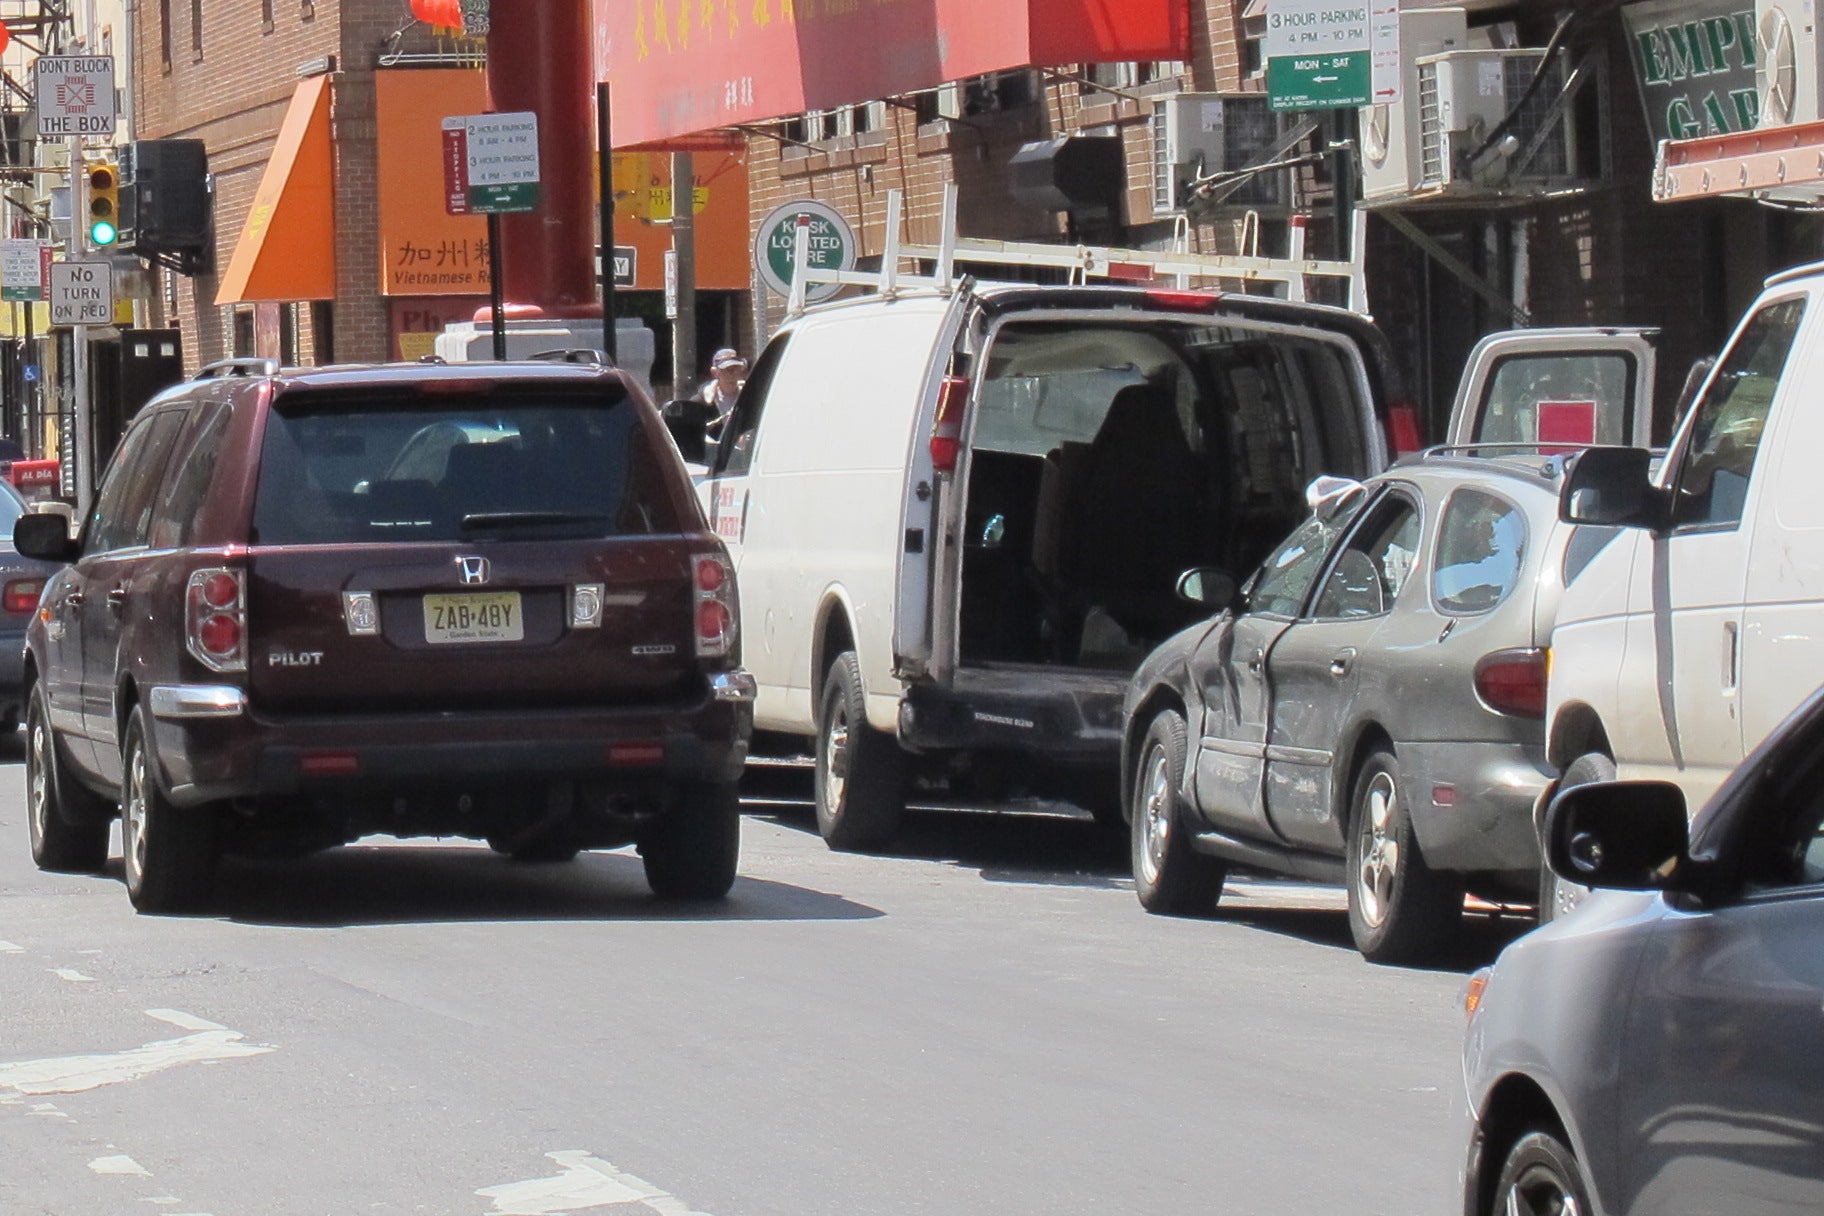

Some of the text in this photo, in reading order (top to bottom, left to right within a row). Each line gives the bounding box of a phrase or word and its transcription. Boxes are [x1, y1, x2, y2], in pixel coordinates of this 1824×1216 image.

[1271, 7, 1366, 29] 3 HOUR PARKING
[1288, 34, 1296, 43] 4
[1300, 32, 1318, 43] PM
[1333, 30, 1344, 41] 10
[1347, 28, 1363, 39] PM
[74, 58, 111, 73] BLOCK
[1294, 60, 1320, 71] MON
[1332, 57, 1351, 69] SAT
[43, 116, 110, 132] THE BOX
[501, 123, 535, 131] PARKING
[71, 270, 94, 282] NO
[395, 270, 473, 284] Vietnamese
[62, 287, 101, 300] TURN
[54, 304, 108, 318] ON RED
[268, 651, 324, 667] PILOT
